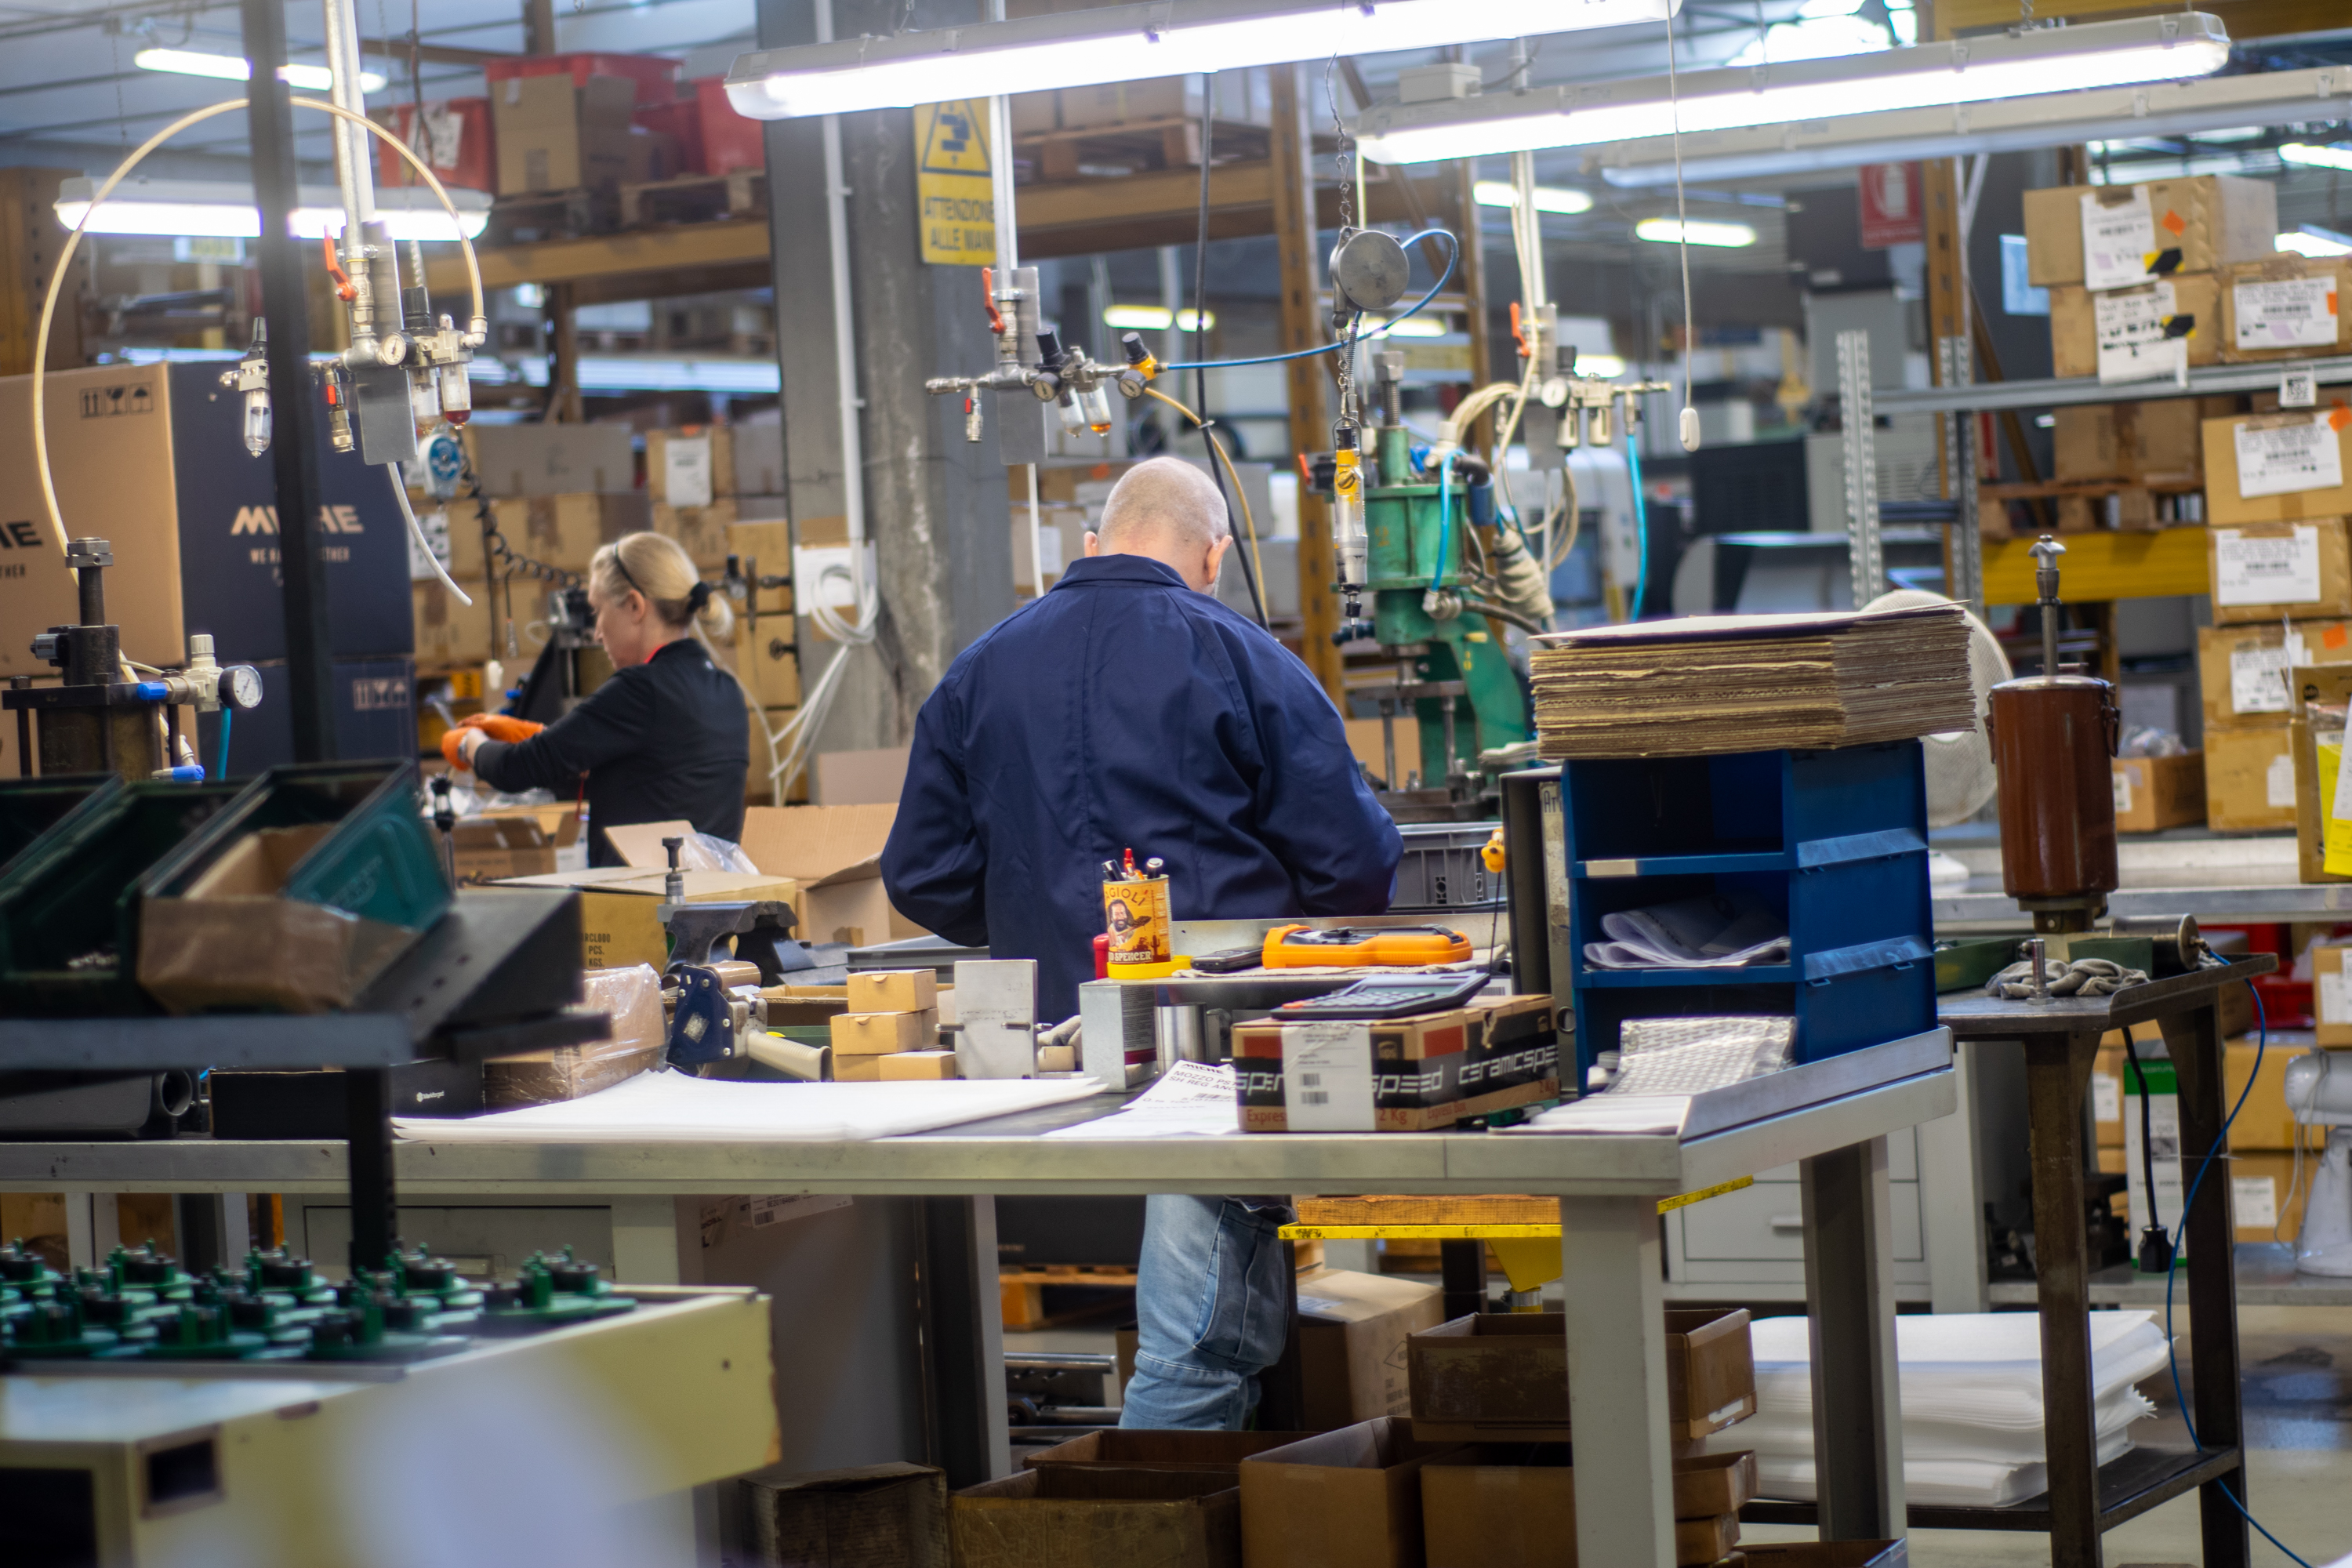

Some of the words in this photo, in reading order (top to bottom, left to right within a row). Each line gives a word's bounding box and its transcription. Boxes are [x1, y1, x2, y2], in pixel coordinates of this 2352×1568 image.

[930, 227, 961, 251] ALLE
[589, 946, 605, 955] PCS.
[1115, 950, 1152, 962] SPENCER
[589, 958, 605, 967] KGS.
[1182, 1063, 1225, 1075] MICHE
[1459, 1045, 1558, 1085] ceramicspe
[1174, 1070, 1214, 1082] MOZZO
[1186, 1079, 1209, 1087] REG
[1379, 1109, 1386, 1122] 2
[1390, 1109, 1408, 1125] Kg
